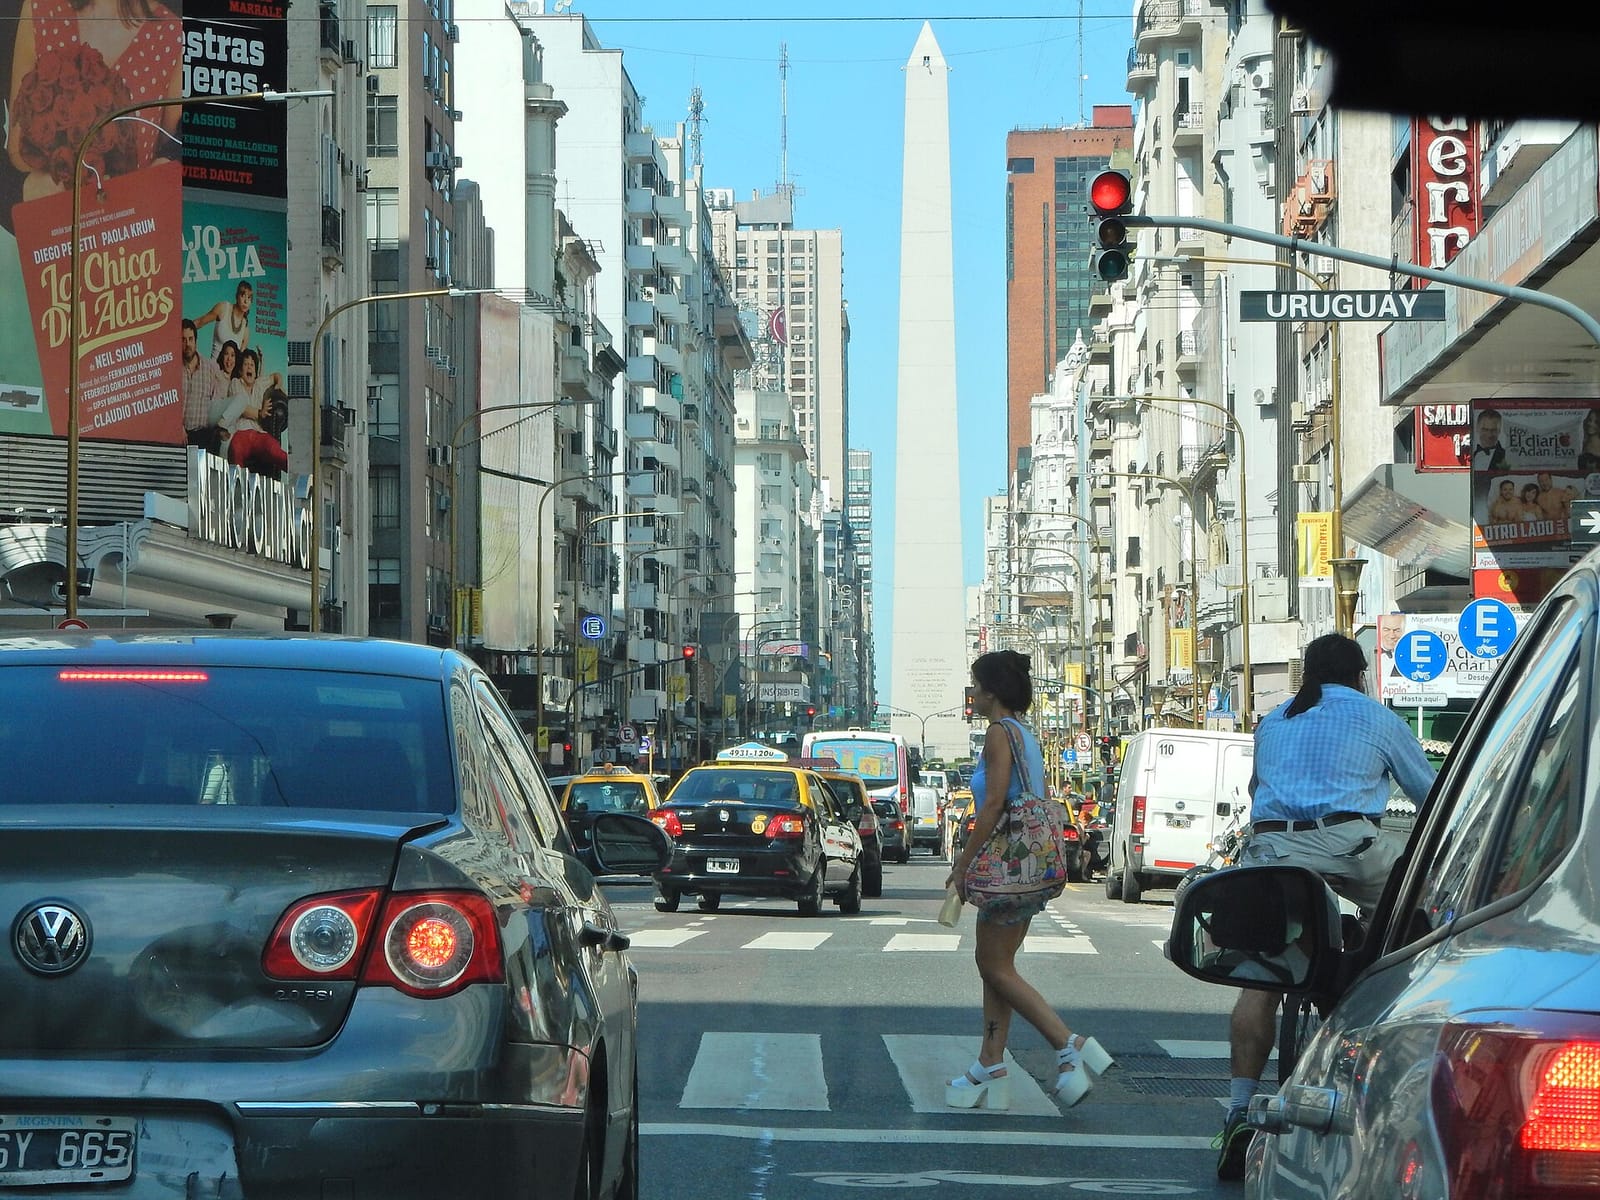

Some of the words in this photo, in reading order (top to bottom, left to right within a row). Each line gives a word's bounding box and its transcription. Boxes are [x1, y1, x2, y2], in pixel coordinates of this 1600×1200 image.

[229, 1, 283, 18] MARRALE
[192, 113, 236, 129] ASSOUS
[209, 169, 253, 185] DAULTE
[33, 246, 61, 264] DIEGO
[62, 235, 97, 257] PEETTI
[101, 226, 129, 246] PAOLA
[130, 218, 156, 238] KRUM
[84, 246, 162, 294] Chica
[1266, 294, 1418, 319] URUGUAY
[95, 351, 115, 369] NEIL
[116, 341, 144, 363] SIMON
[94, 407, 131, 428] CLAUDIO
[133, 388, 179, 416] TOLCACHIR
[197, 449, 297, 563] METROPOLITAN
[1484, 524, 1518, 540] OTRO
[1520, 520, 1554, 538] LADO
[1476, 605, 1499, 637] E
[1410, 635, 1432, 663] E
[1067, 750, 1073, 758] E
[1159, 744, 1174, 755] 110
[16, 1116, 84, 1127] ARGENTINA
[57, 1131, 129, 1168] 665
